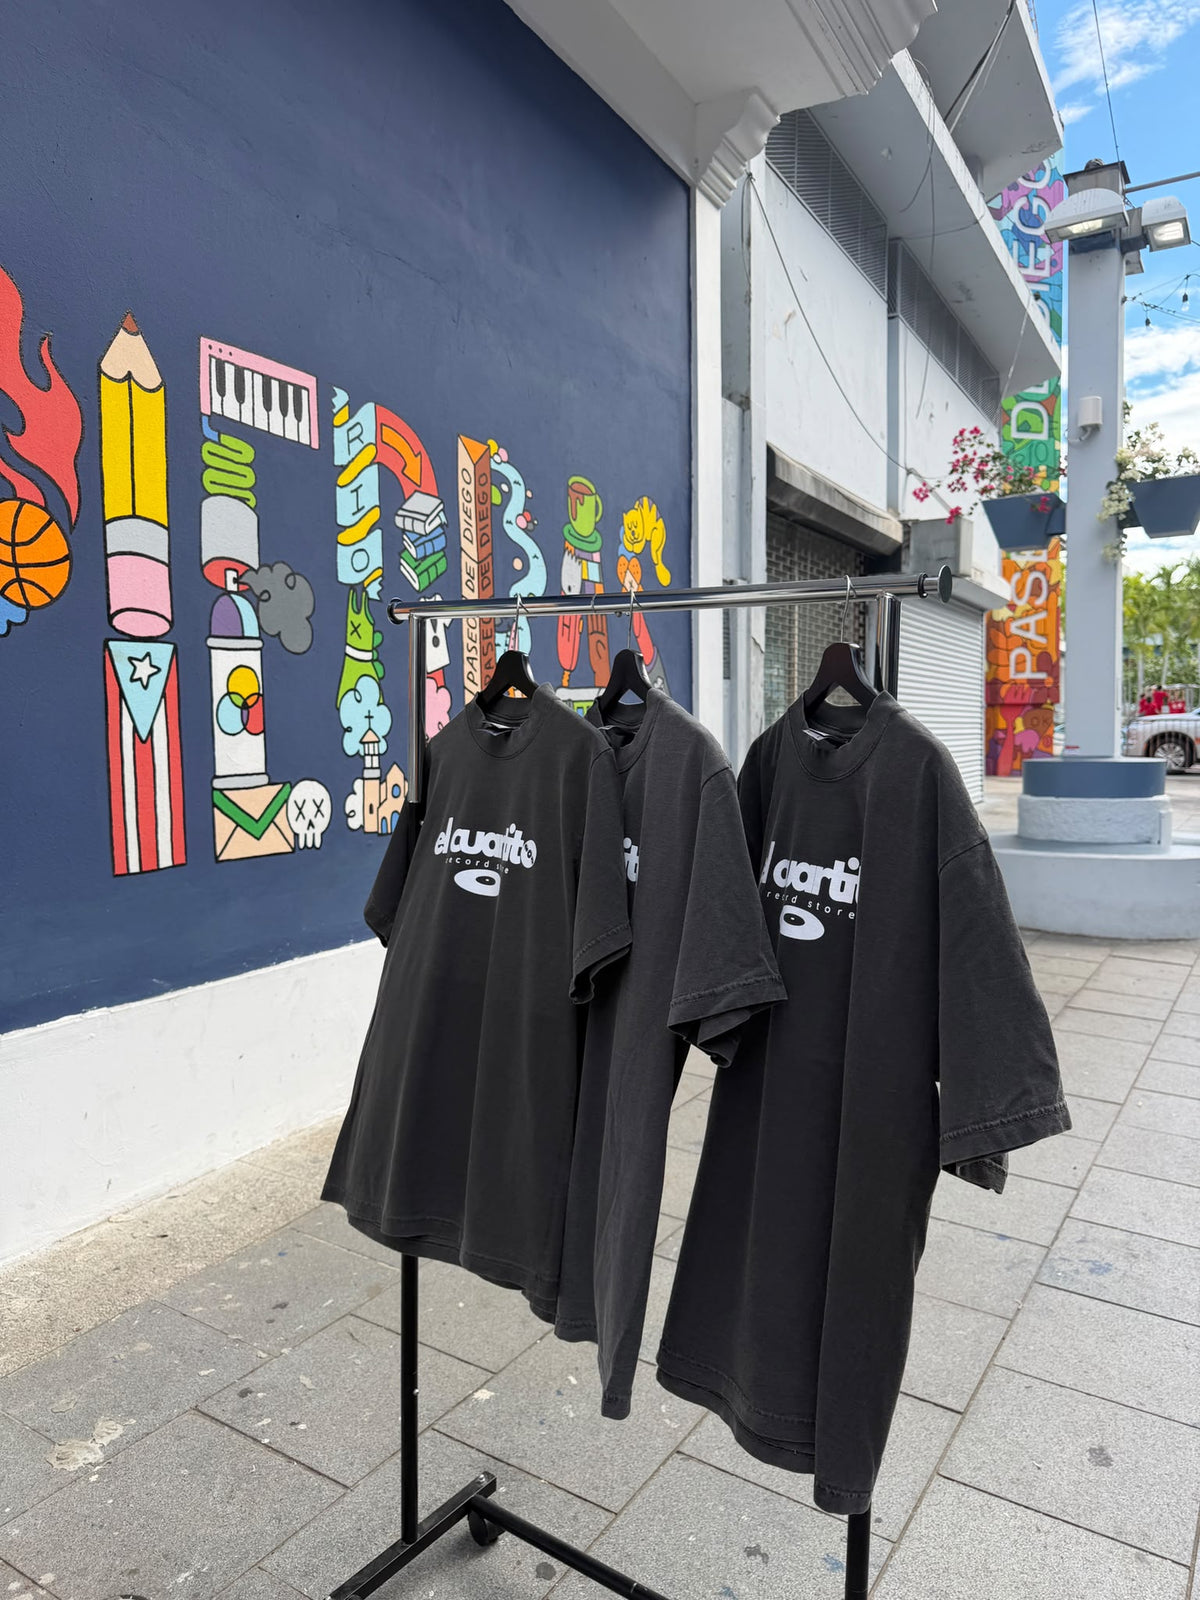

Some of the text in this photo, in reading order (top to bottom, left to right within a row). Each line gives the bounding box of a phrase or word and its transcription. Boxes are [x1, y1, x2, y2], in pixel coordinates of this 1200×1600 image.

[346, 421, 370, 573] RIO
[477, 471, 490, 549] DIEGO
[461, 467, 478, 687] PASEO DE DIEGO
[480, 559, 491, 590] DE
[807, 900, 856, 919] store
